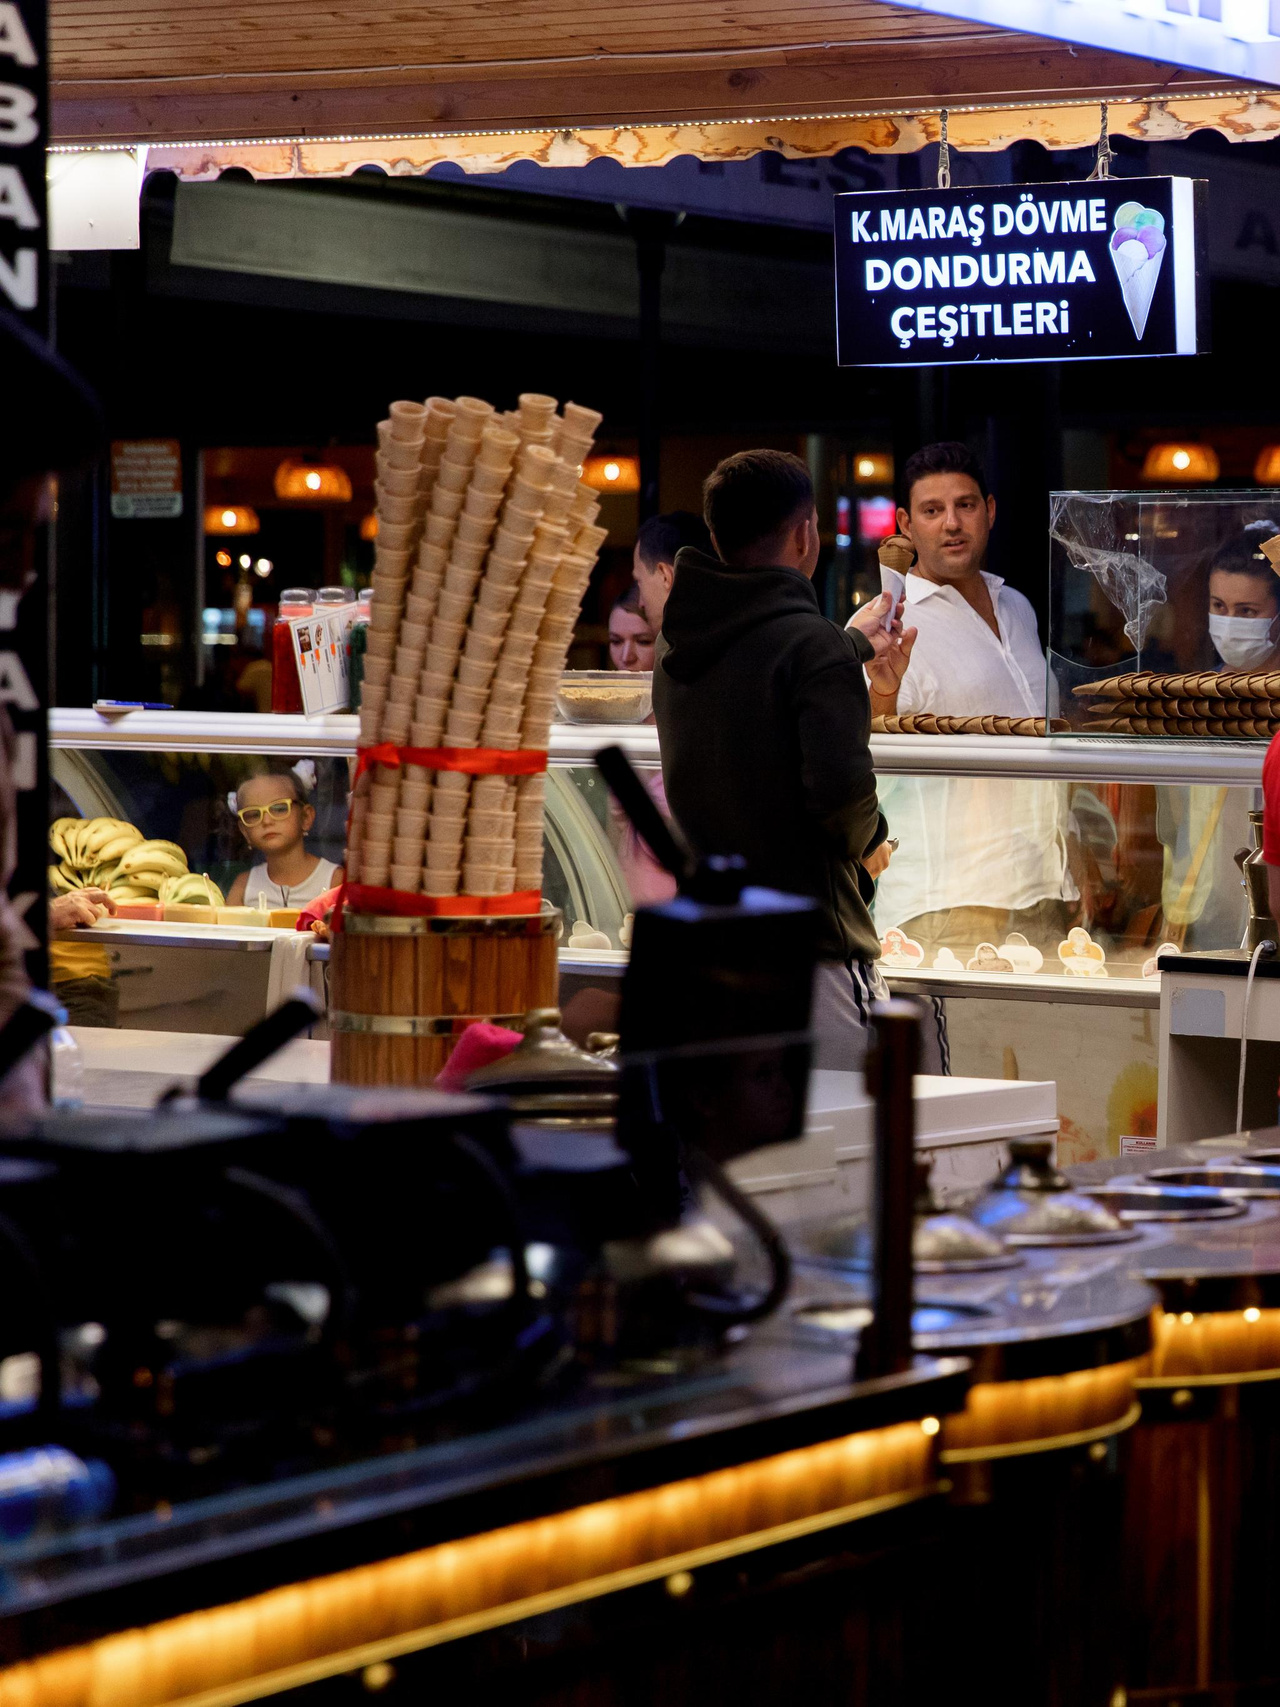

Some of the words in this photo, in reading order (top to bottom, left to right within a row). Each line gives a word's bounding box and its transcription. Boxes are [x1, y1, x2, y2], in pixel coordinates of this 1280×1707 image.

[852, 204, 985, 247] K.MARAŞ
[993, 194, 1107, 236] DÖVME
[865, 250, 1096, 291] DONDURMA
